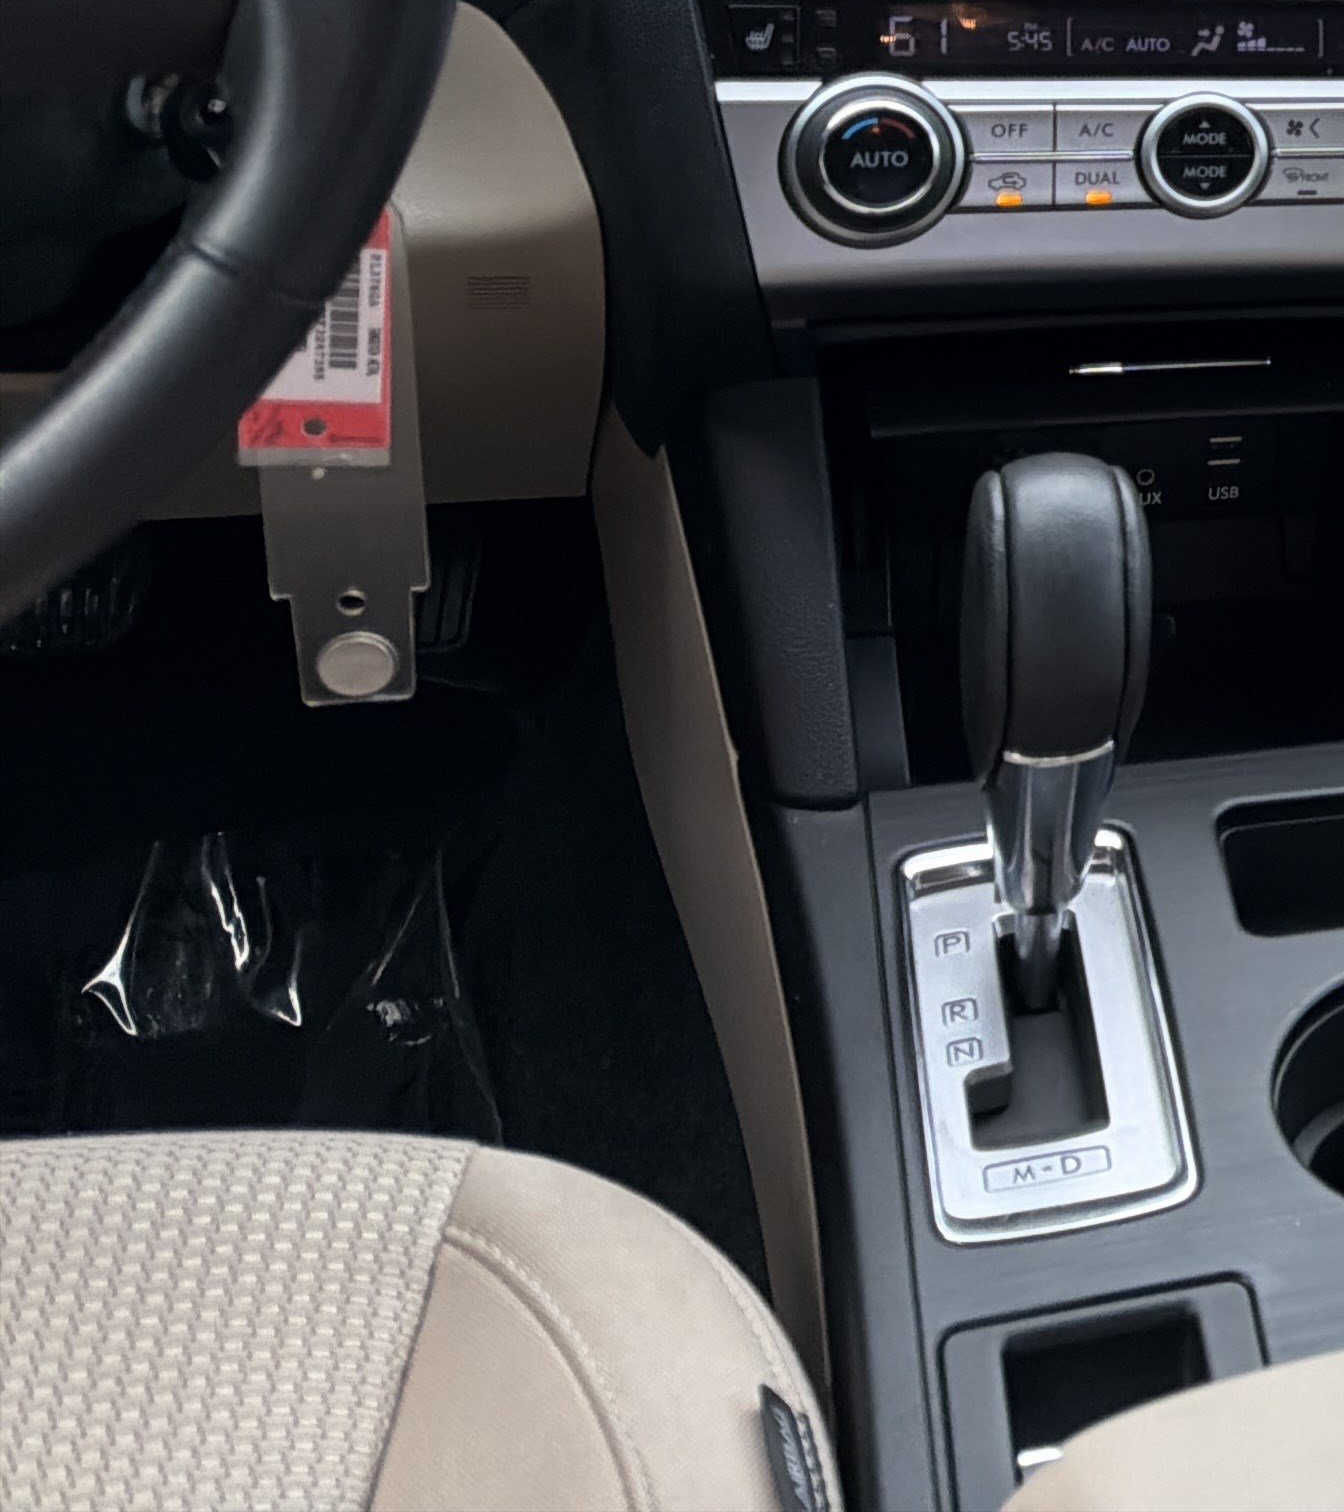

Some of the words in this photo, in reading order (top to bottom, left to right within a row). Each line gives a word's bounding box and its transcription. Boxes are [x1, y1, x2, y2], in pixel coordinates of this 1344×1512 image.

[1008, 31, 1053, 52] 5:45
[1081, 38, 1114, 52] A/C
[1125, 38, 1171, 52] AUTO
[991, 123, 1028, 138] OFF
[1079, 122, 1114, 138] A/C
[1183, 131, 1227, 146] MODE
[850, 150, 908, 169] AUTO
[1075, 171, 1121, 187] DUAL
[1183, 164, 1227, 179] MODE
[1139, 491, 1162, 506] UX
[1208, 486, 1240, 501] USB
[943, 937, 961, 955] P
[950, 1004, 968, 1020] R
[953, 1042, 976, 1063] N
